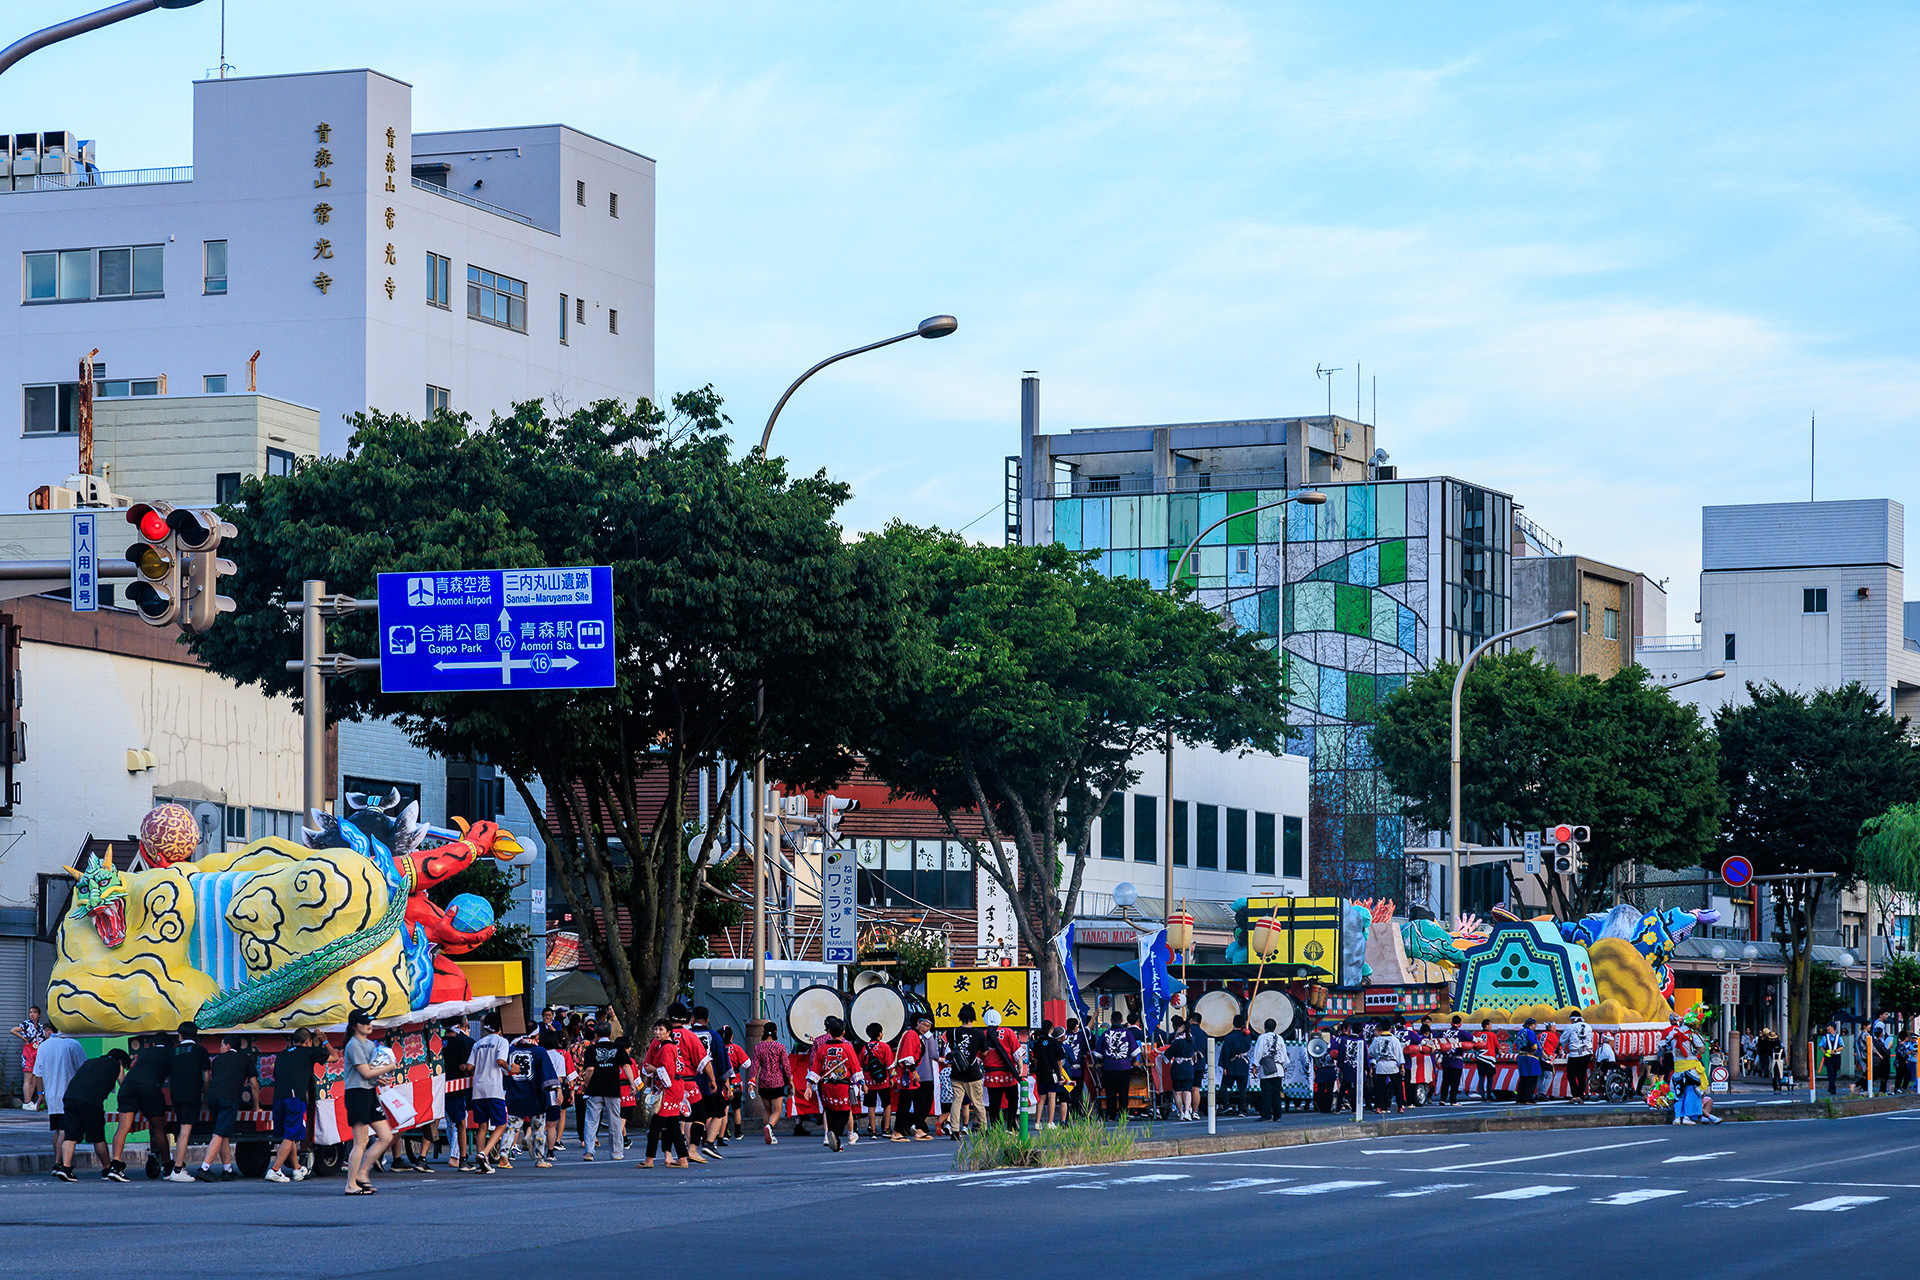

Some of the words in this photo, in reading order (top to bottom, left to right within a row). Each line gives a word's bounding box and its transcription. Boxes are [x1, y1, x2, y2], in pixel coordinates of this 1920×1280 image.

[312, 121, 334, 295] 青森山常光寺
[77, 521, 91, 604] 盲人用信号
[436, 576, 492, 594] 青森空港
[505, 572, 590, 592] 三内丸山遺跡
[436, 596, 464, 606] Aomori
[466, 595, 492, 606] Airport
[505, 593, 573, 604] Sannai-Maruyama
[575, 592, 590, 602] Site
[419, 623, 491, 643] 合浦公園
[520, 620, 574, 640] 青森駅
[428, 643, 458, 656] Gappo
[461, 643, 482, 654] Park
[499, 635, 511, 648] 16
[520, 641, 553, 652] Aomori
[556, 640, 575, 651] Sta.
[534, 656, 547, 669] 16
[1526, 834, 1534, 872] 本町一丁目
[843, 864, 853, 916] ねぶたの家
[1081, 930, 1109, 943] YANAGI
[1112, 930, 1137, 943] MACHI
[828, 949, 837, 960] P
[953, 975, 999, 993] 安田
